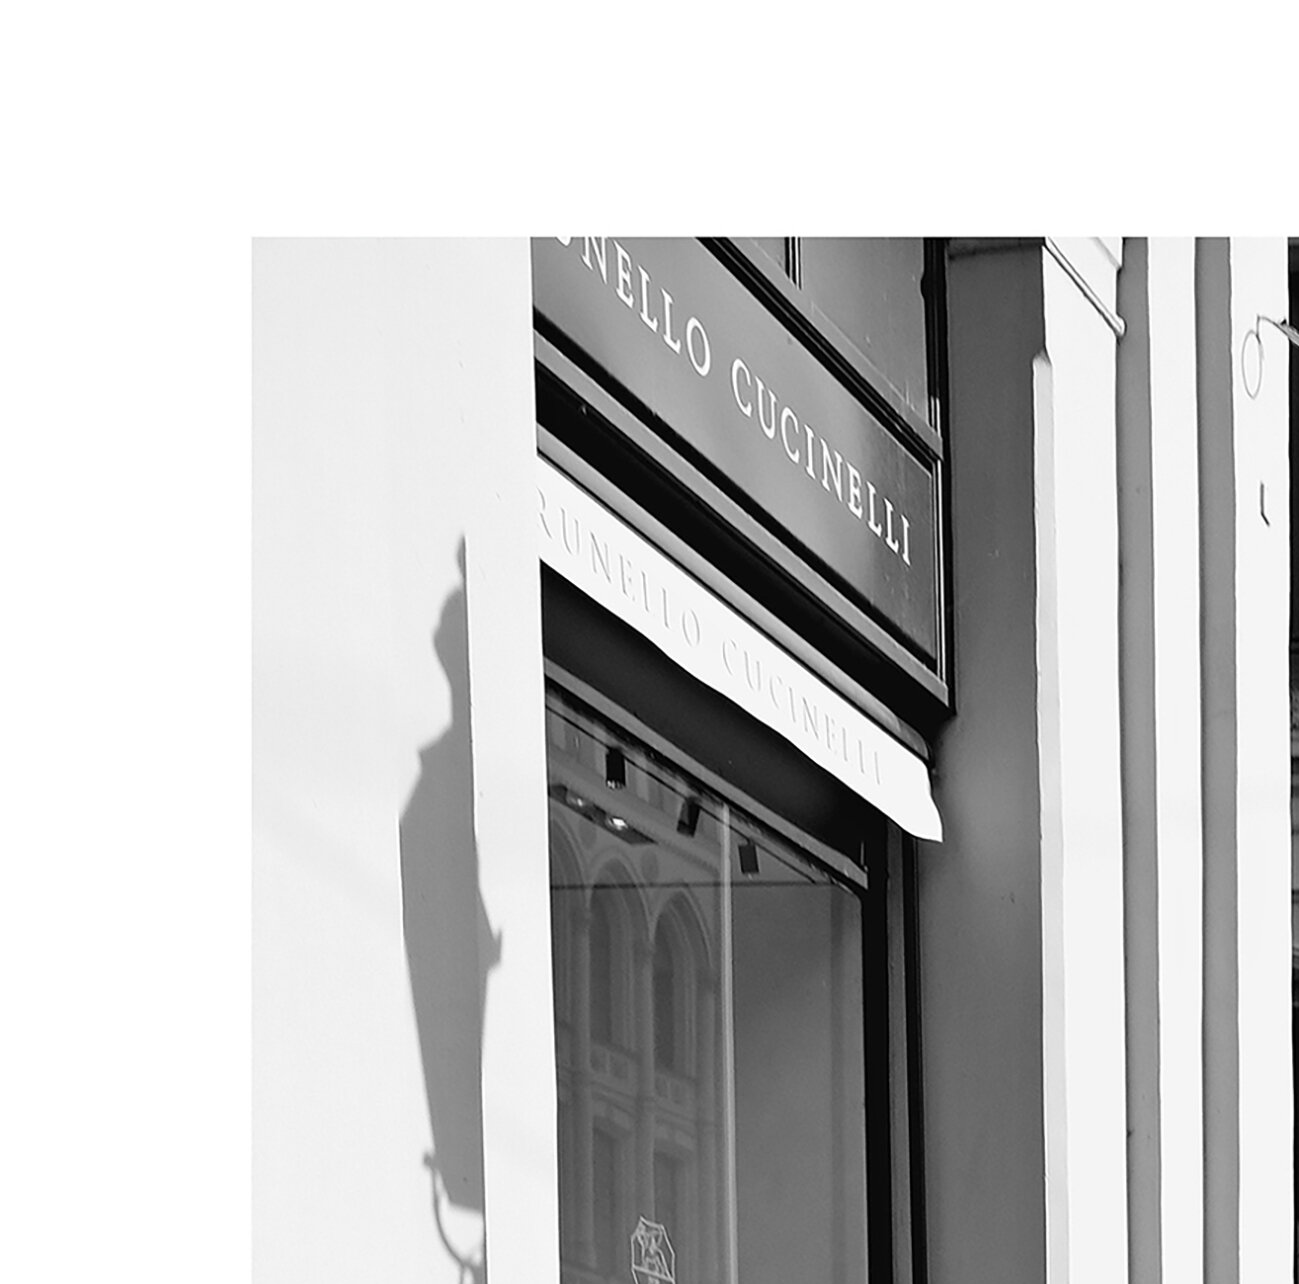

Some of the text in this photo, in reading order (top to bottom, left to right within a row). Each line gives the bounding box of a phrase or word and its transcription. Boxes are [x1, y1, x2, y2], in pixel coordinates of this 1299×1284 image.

[555, 236, 913, 567] NELLO CUCINELLI
[722, 638, 881, 786] CUCINELLI
